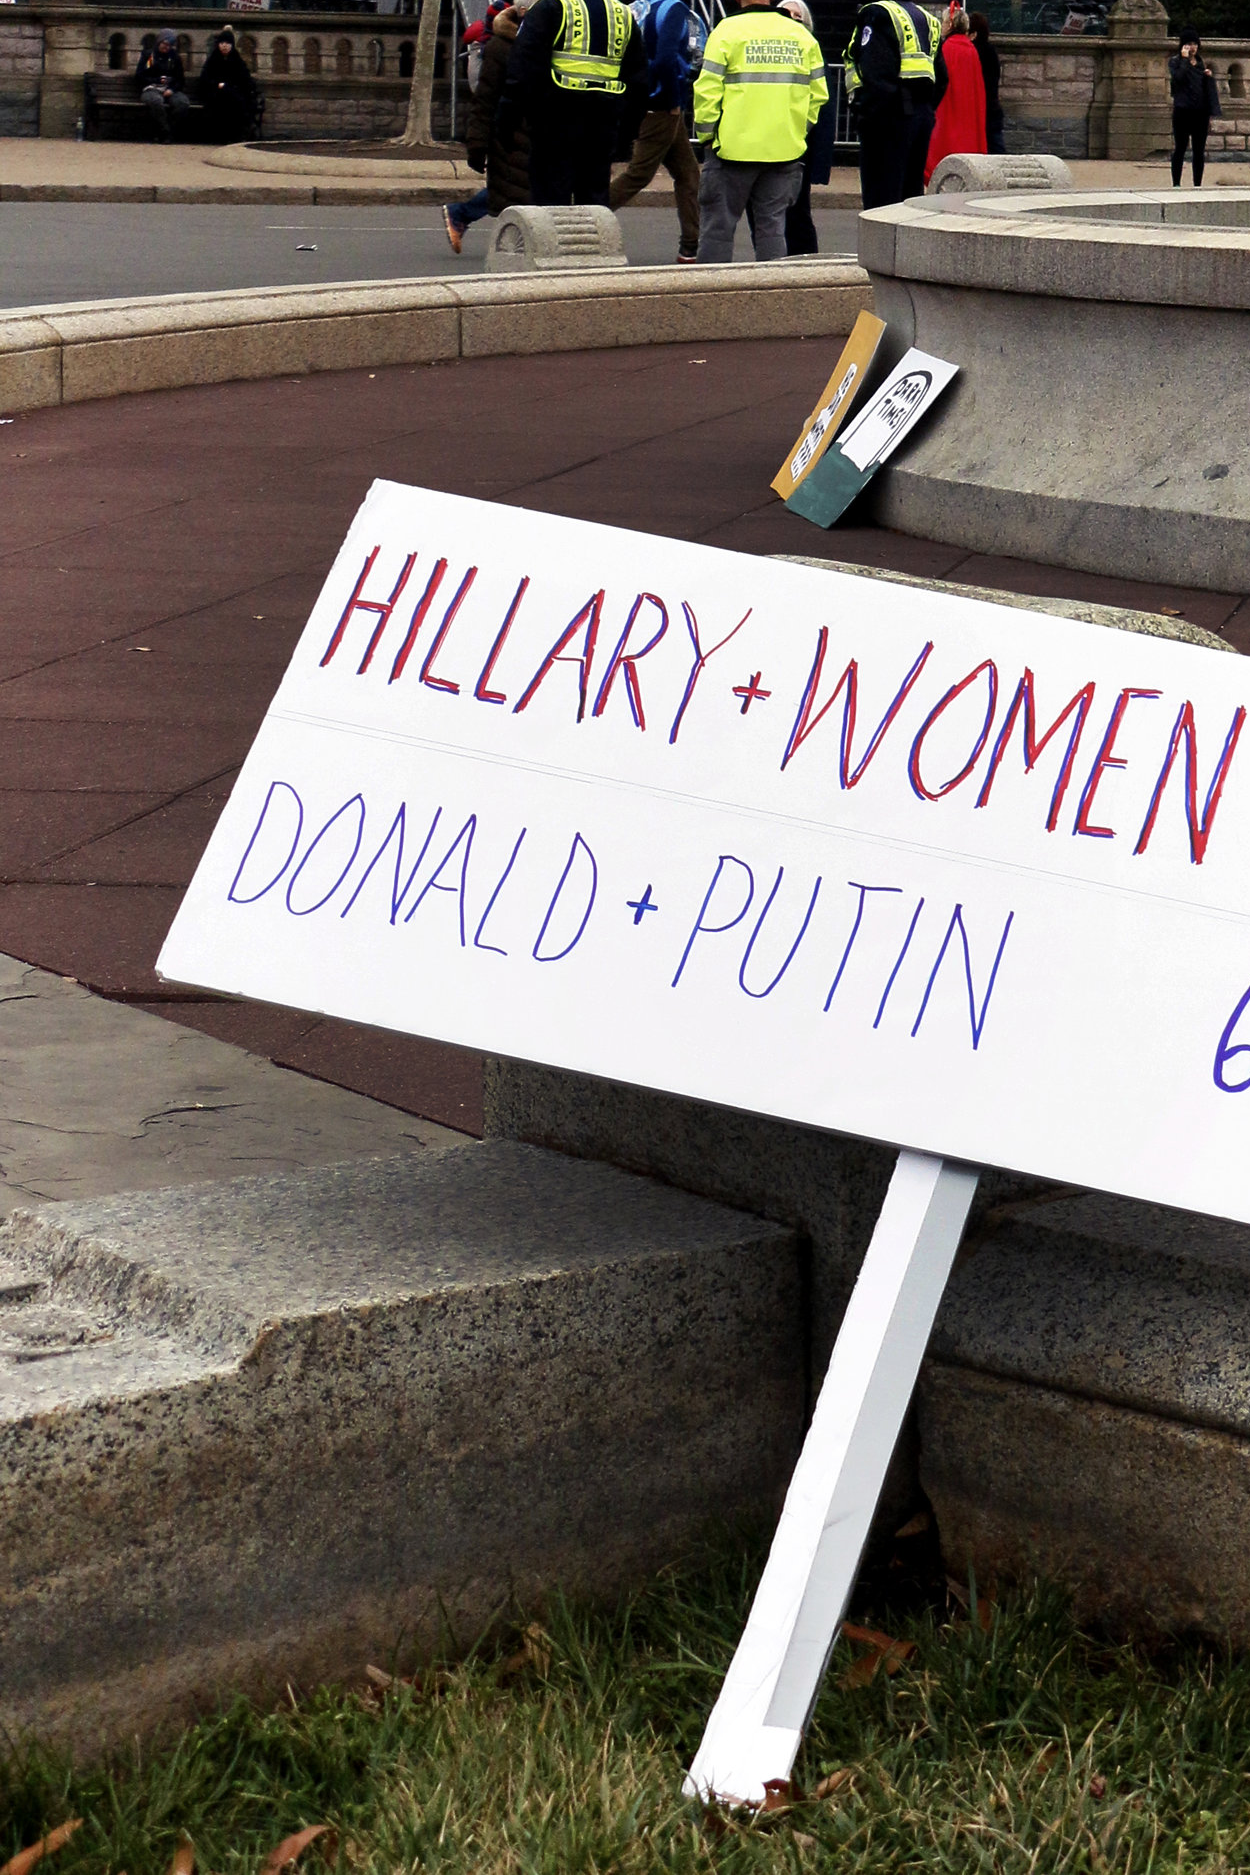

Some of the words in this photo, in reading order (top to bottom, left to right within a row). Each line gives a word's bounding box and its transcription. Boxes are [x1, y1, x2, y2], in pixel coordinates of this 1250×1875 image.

[746, 46, 804, 56] EMERGENCY
[746, 55, 803, 66] MANAGEMENT
[892, 379, 921, 404] DARK
[877, 398, 907, 429] TIMES
[320, 547, 752, 744] HILLARY
[781, 627, 1246, 865] WOMEN
[228, 782, 597, 961] DONALD
[672, 856, 1013, 1050] PUTIN
